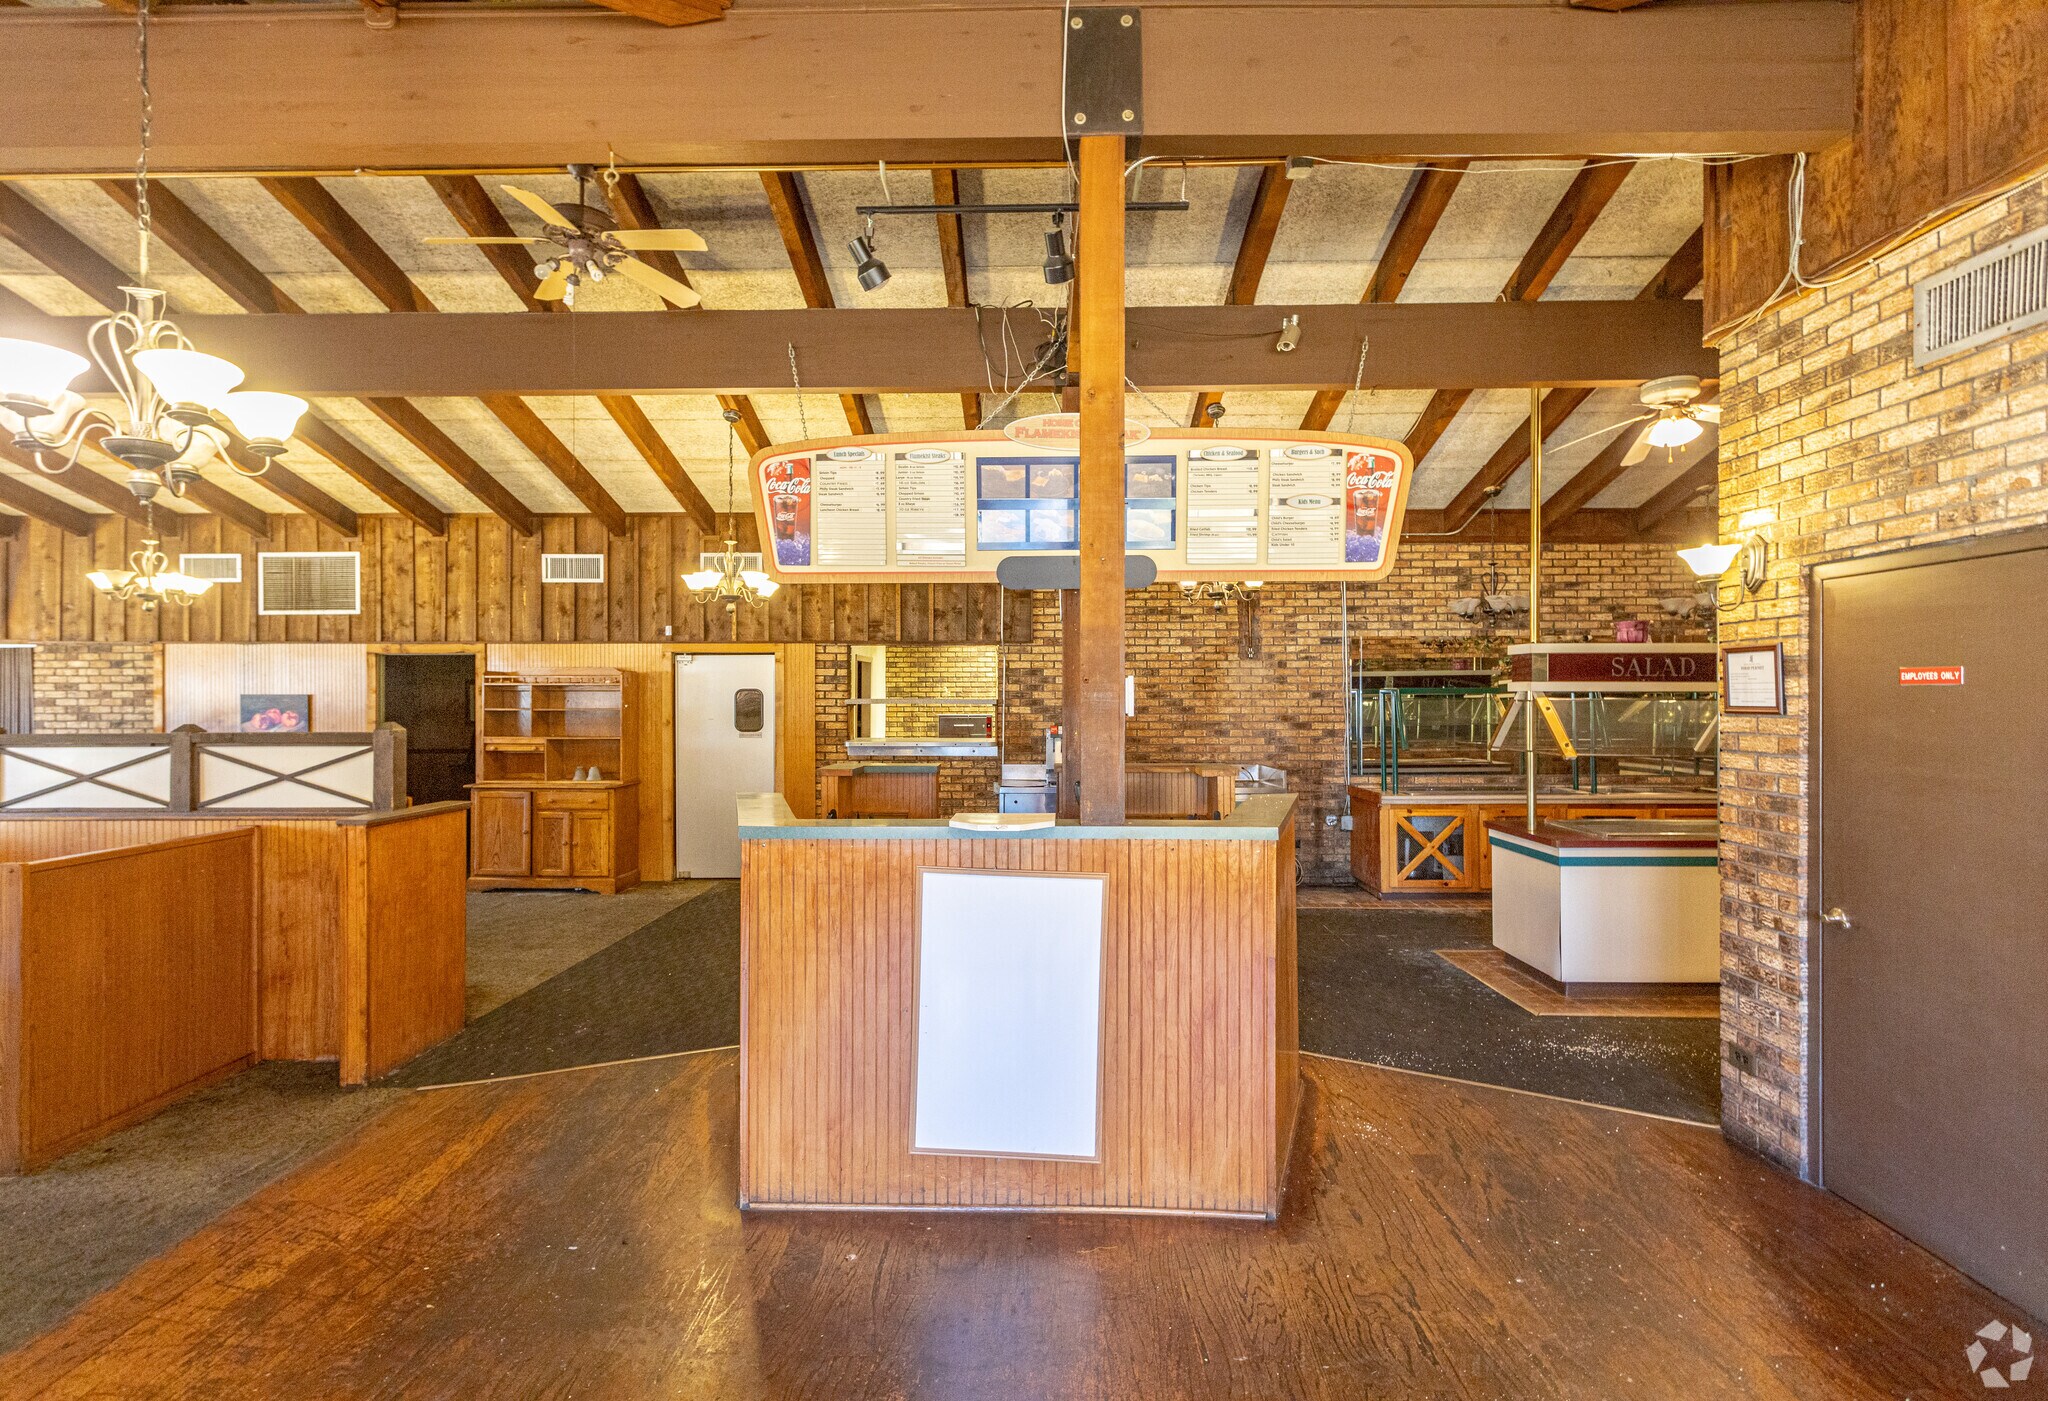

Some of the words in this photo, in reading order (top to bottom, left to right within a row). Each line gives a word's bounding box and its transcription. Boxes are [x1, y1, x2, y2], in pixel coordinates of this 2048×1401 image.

[1611, 657, 1696, 677] SALAD
[1901, 671, 1938, 681] EMPLOYEES
[1940, 671, 1960, 680] ONLY
